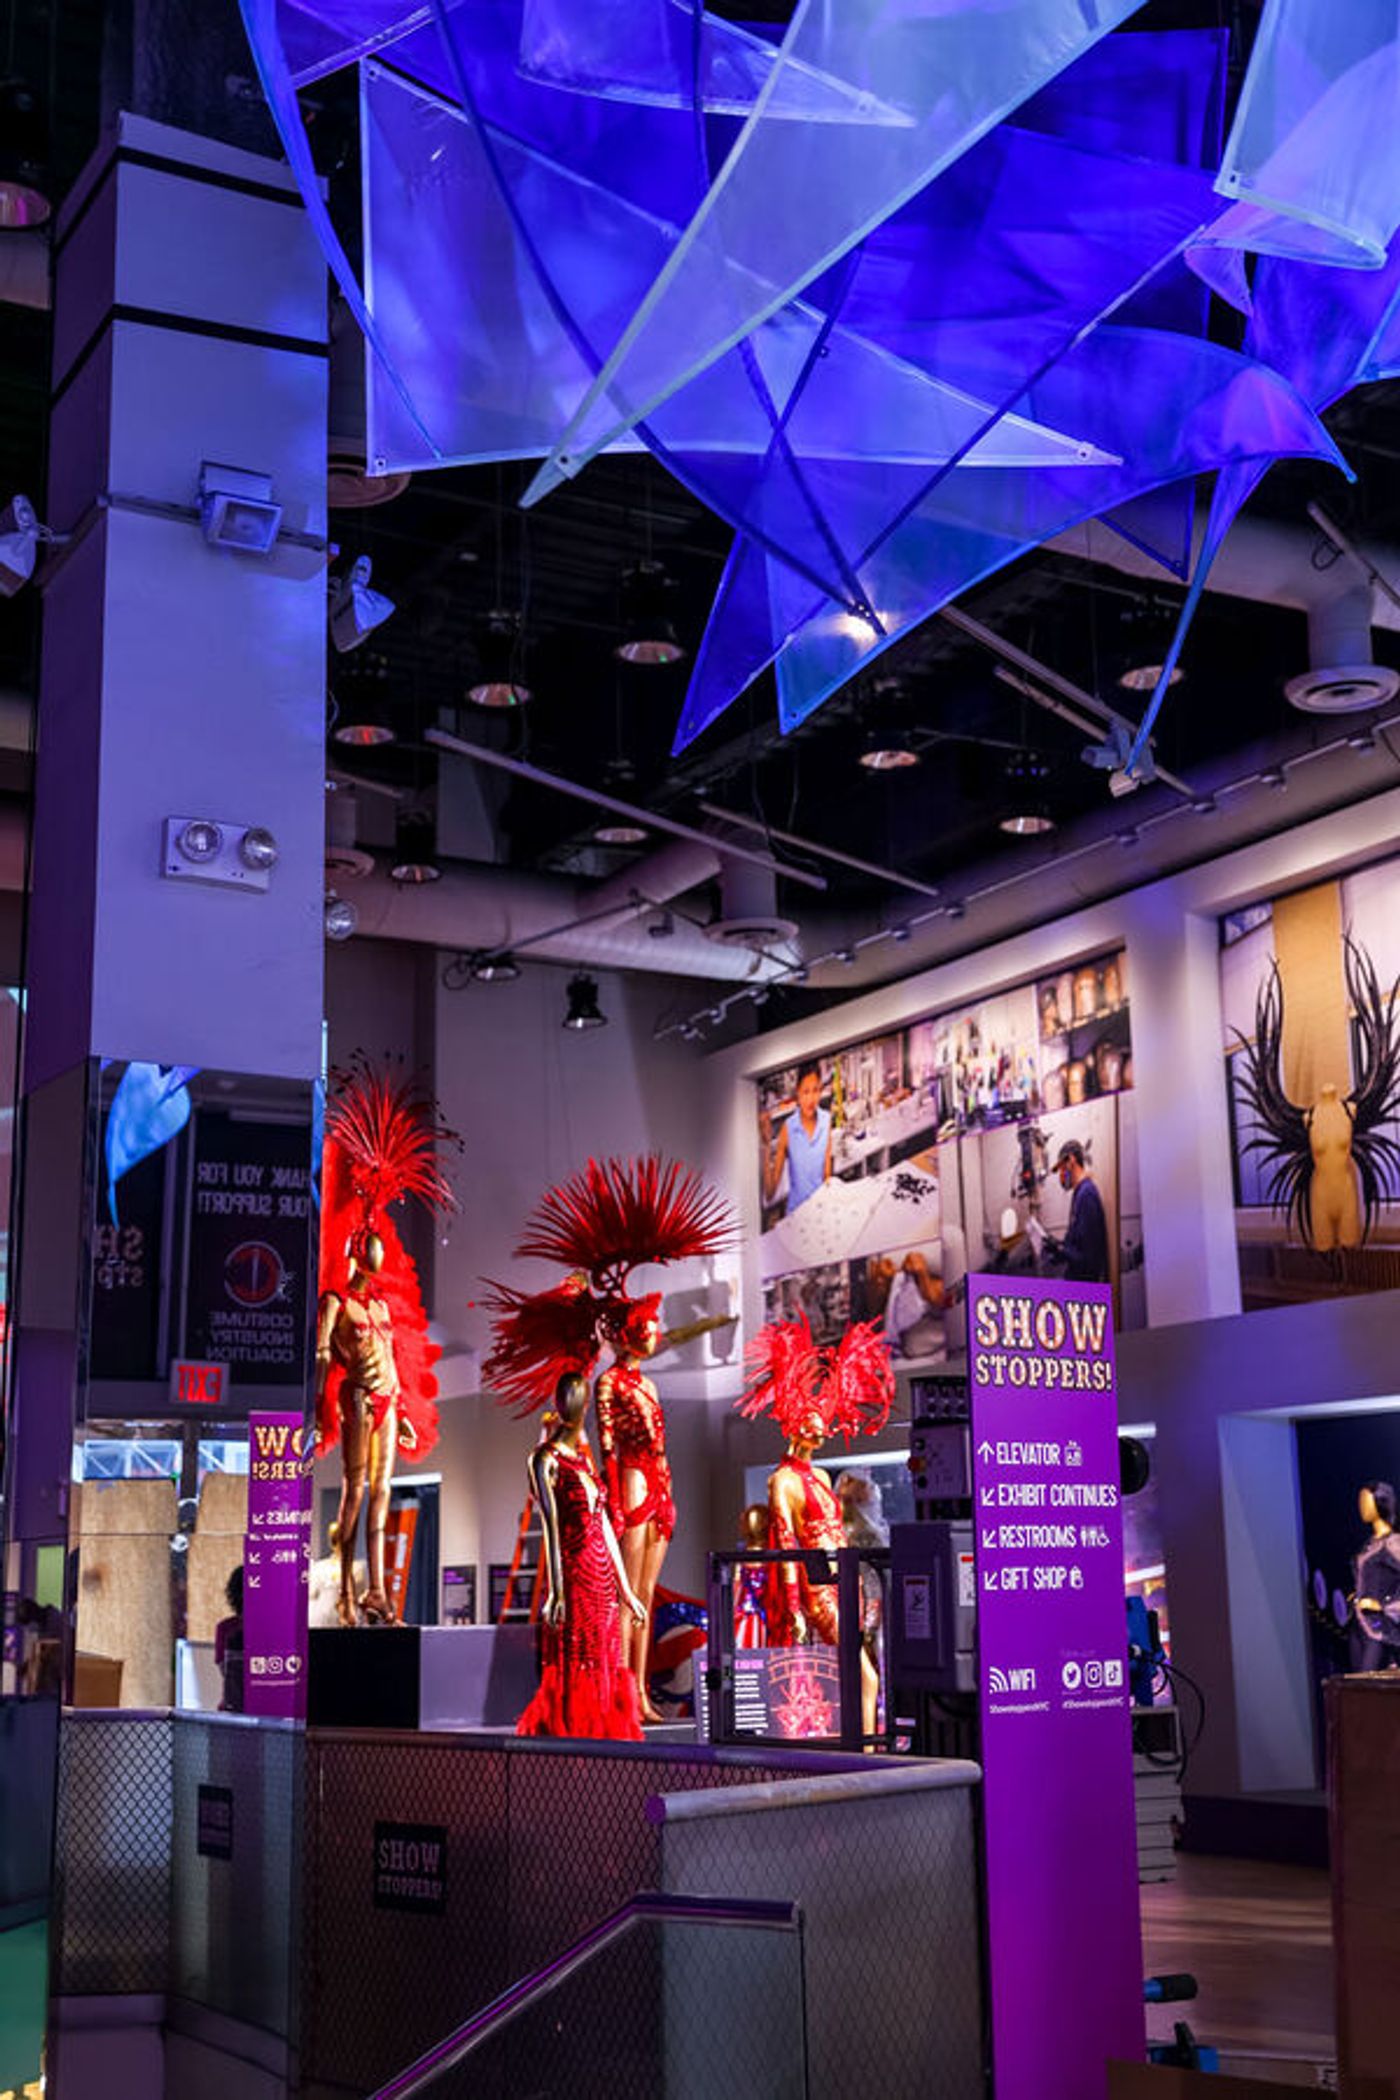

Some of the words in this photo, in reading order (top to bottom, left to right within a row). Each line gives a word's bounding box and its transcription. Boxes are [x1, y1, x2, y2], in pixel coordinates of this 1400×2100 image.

[975, 1296, 1107, 1353] SHOW
[975, 1354, 1112, 1391] STOPPERS!
[996, 1441, 1061, 1465] ELEVATOR
[998, 1484, 1046, 1507] EXHIBIT
[1050, 1484, 1118, 1507] CONTINUES
[1000, 1525, 1076, 1548] RESTROOMS
[1001, 1566, 1029, 1590] GIFT
[1033, 1565, 1067, 1590] SHOP
[378, 1839, 441, 1873] SHOW
